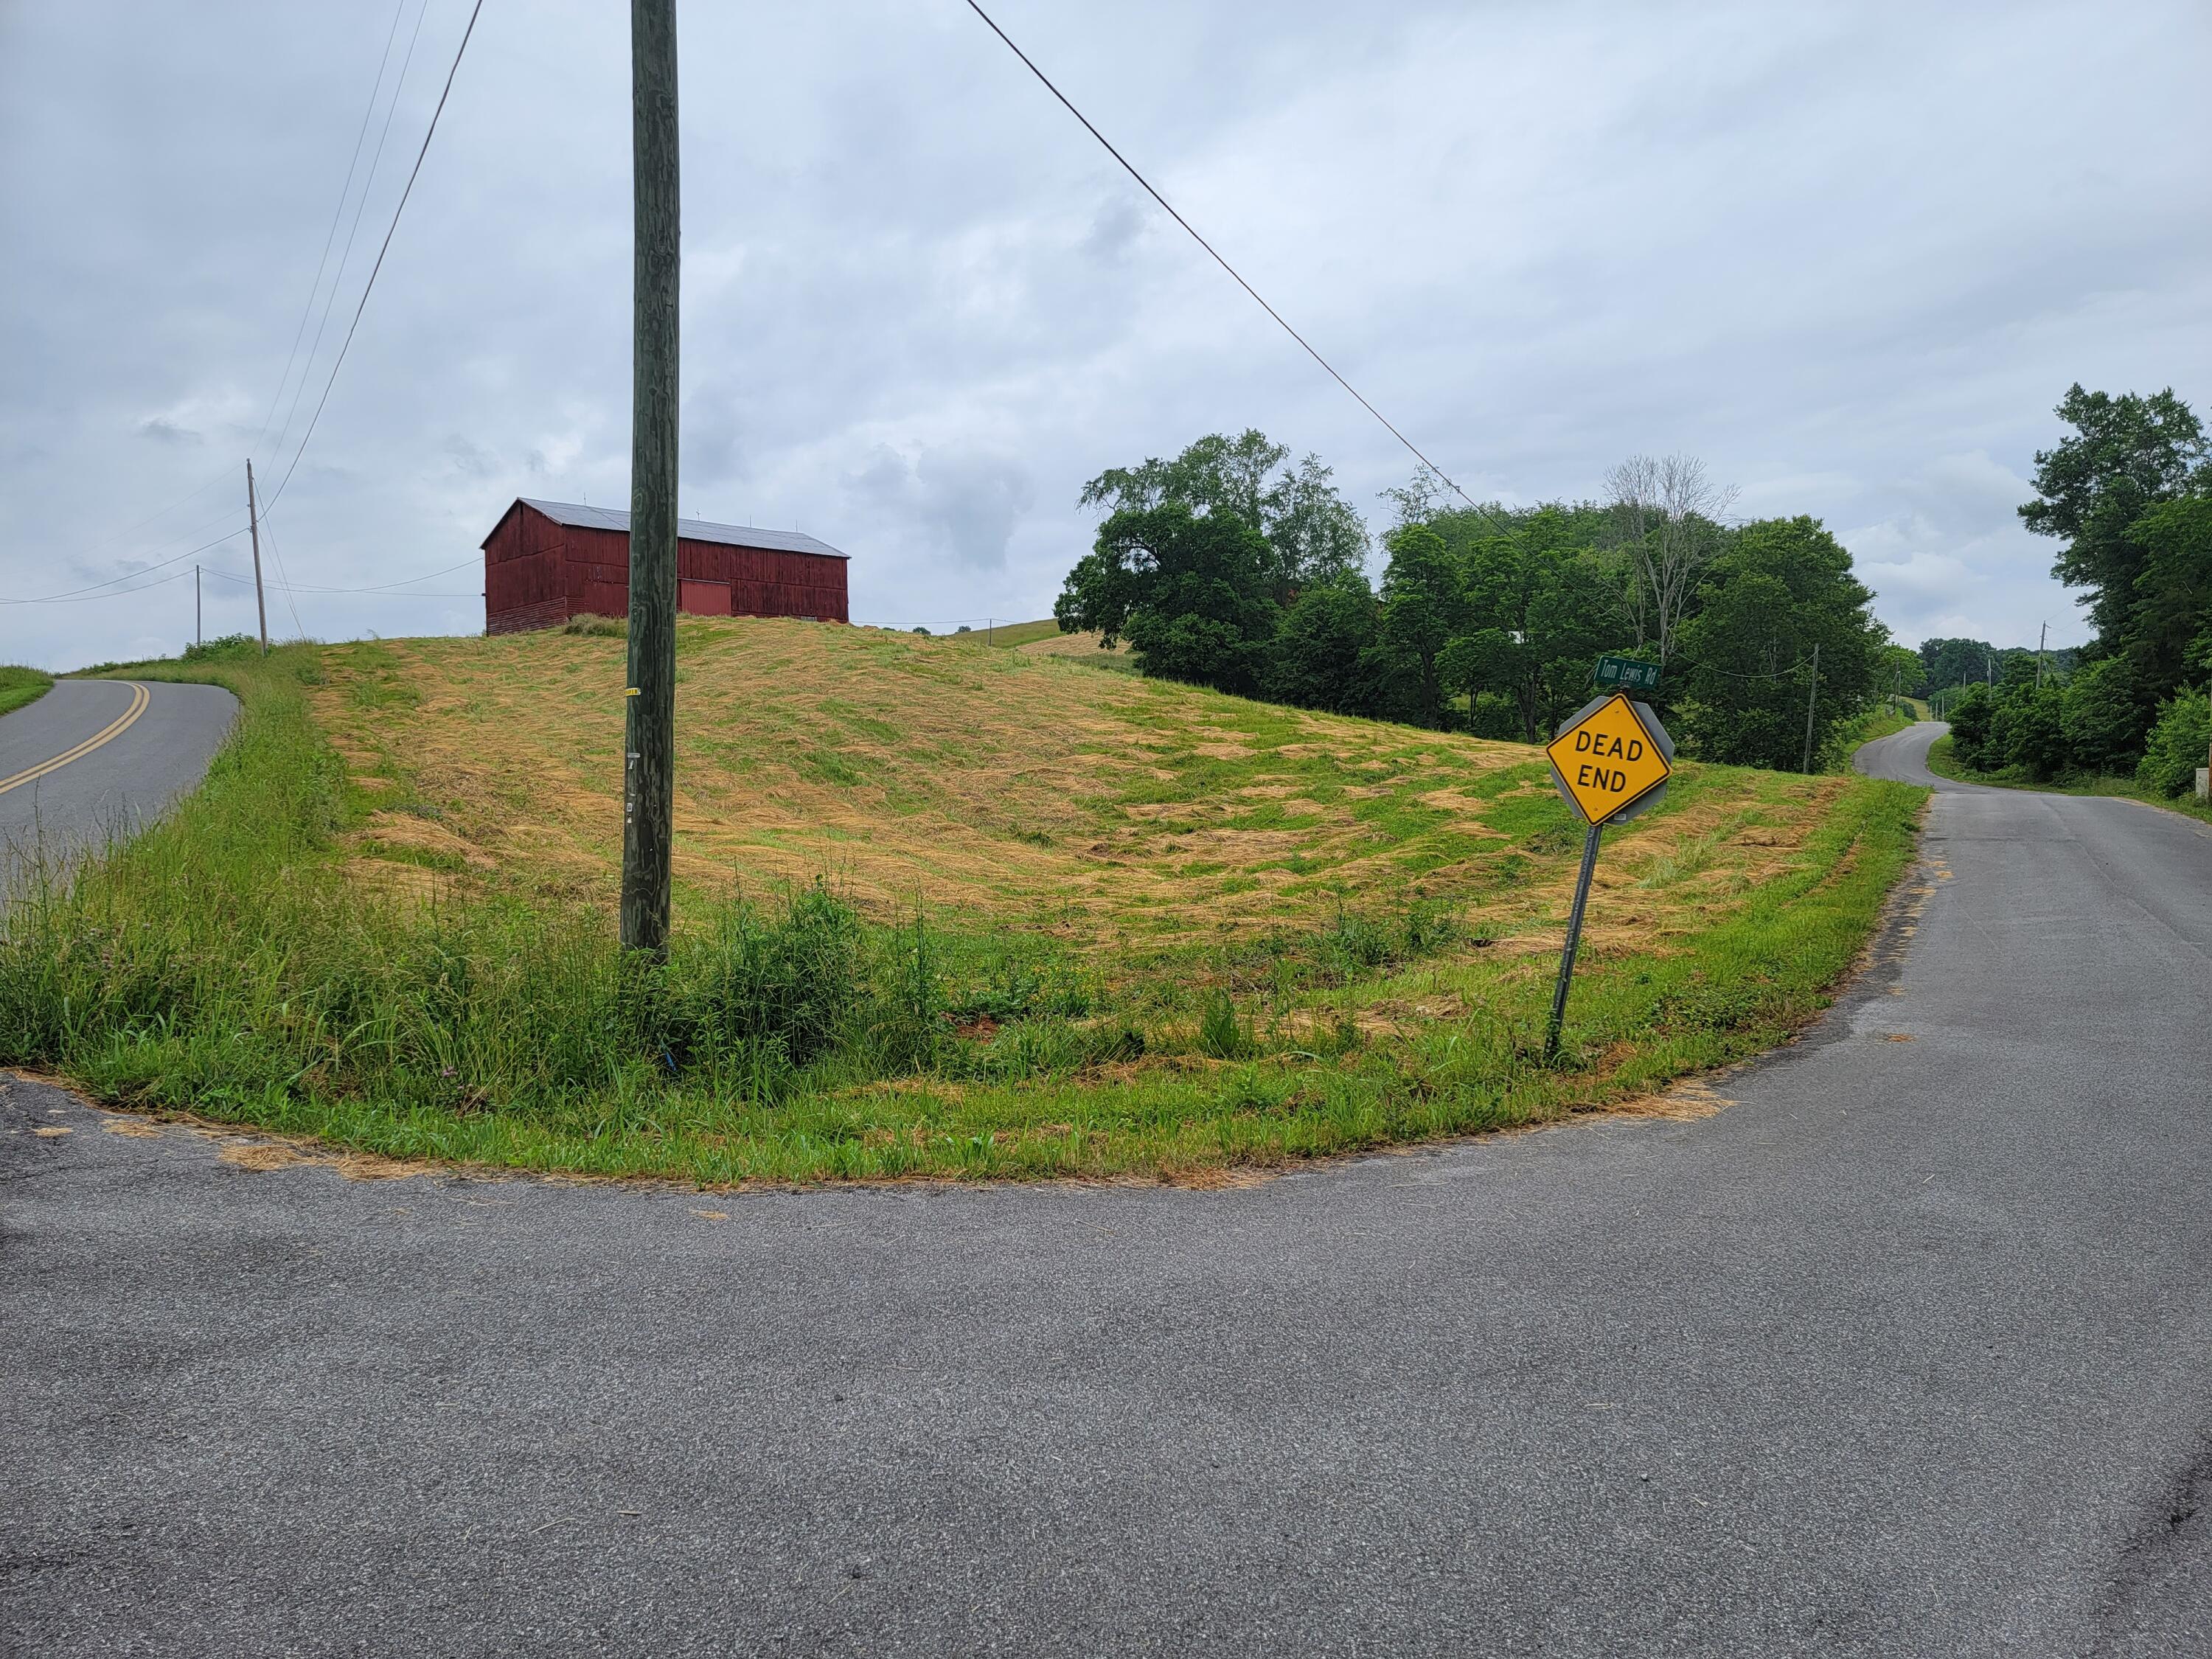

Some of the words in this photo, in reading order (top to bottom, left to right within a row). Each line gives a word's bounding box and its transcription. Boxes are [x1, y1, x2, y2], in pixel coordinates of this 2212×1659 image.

[1601, 659, 1618, 678] Tom
[1620, 662, 1643, 683] Lewis
[1645, 667, 1658, 685] Rd
[1575, 731, 1643, 762] DEAD
[1577, 765, 1626, 793] END
